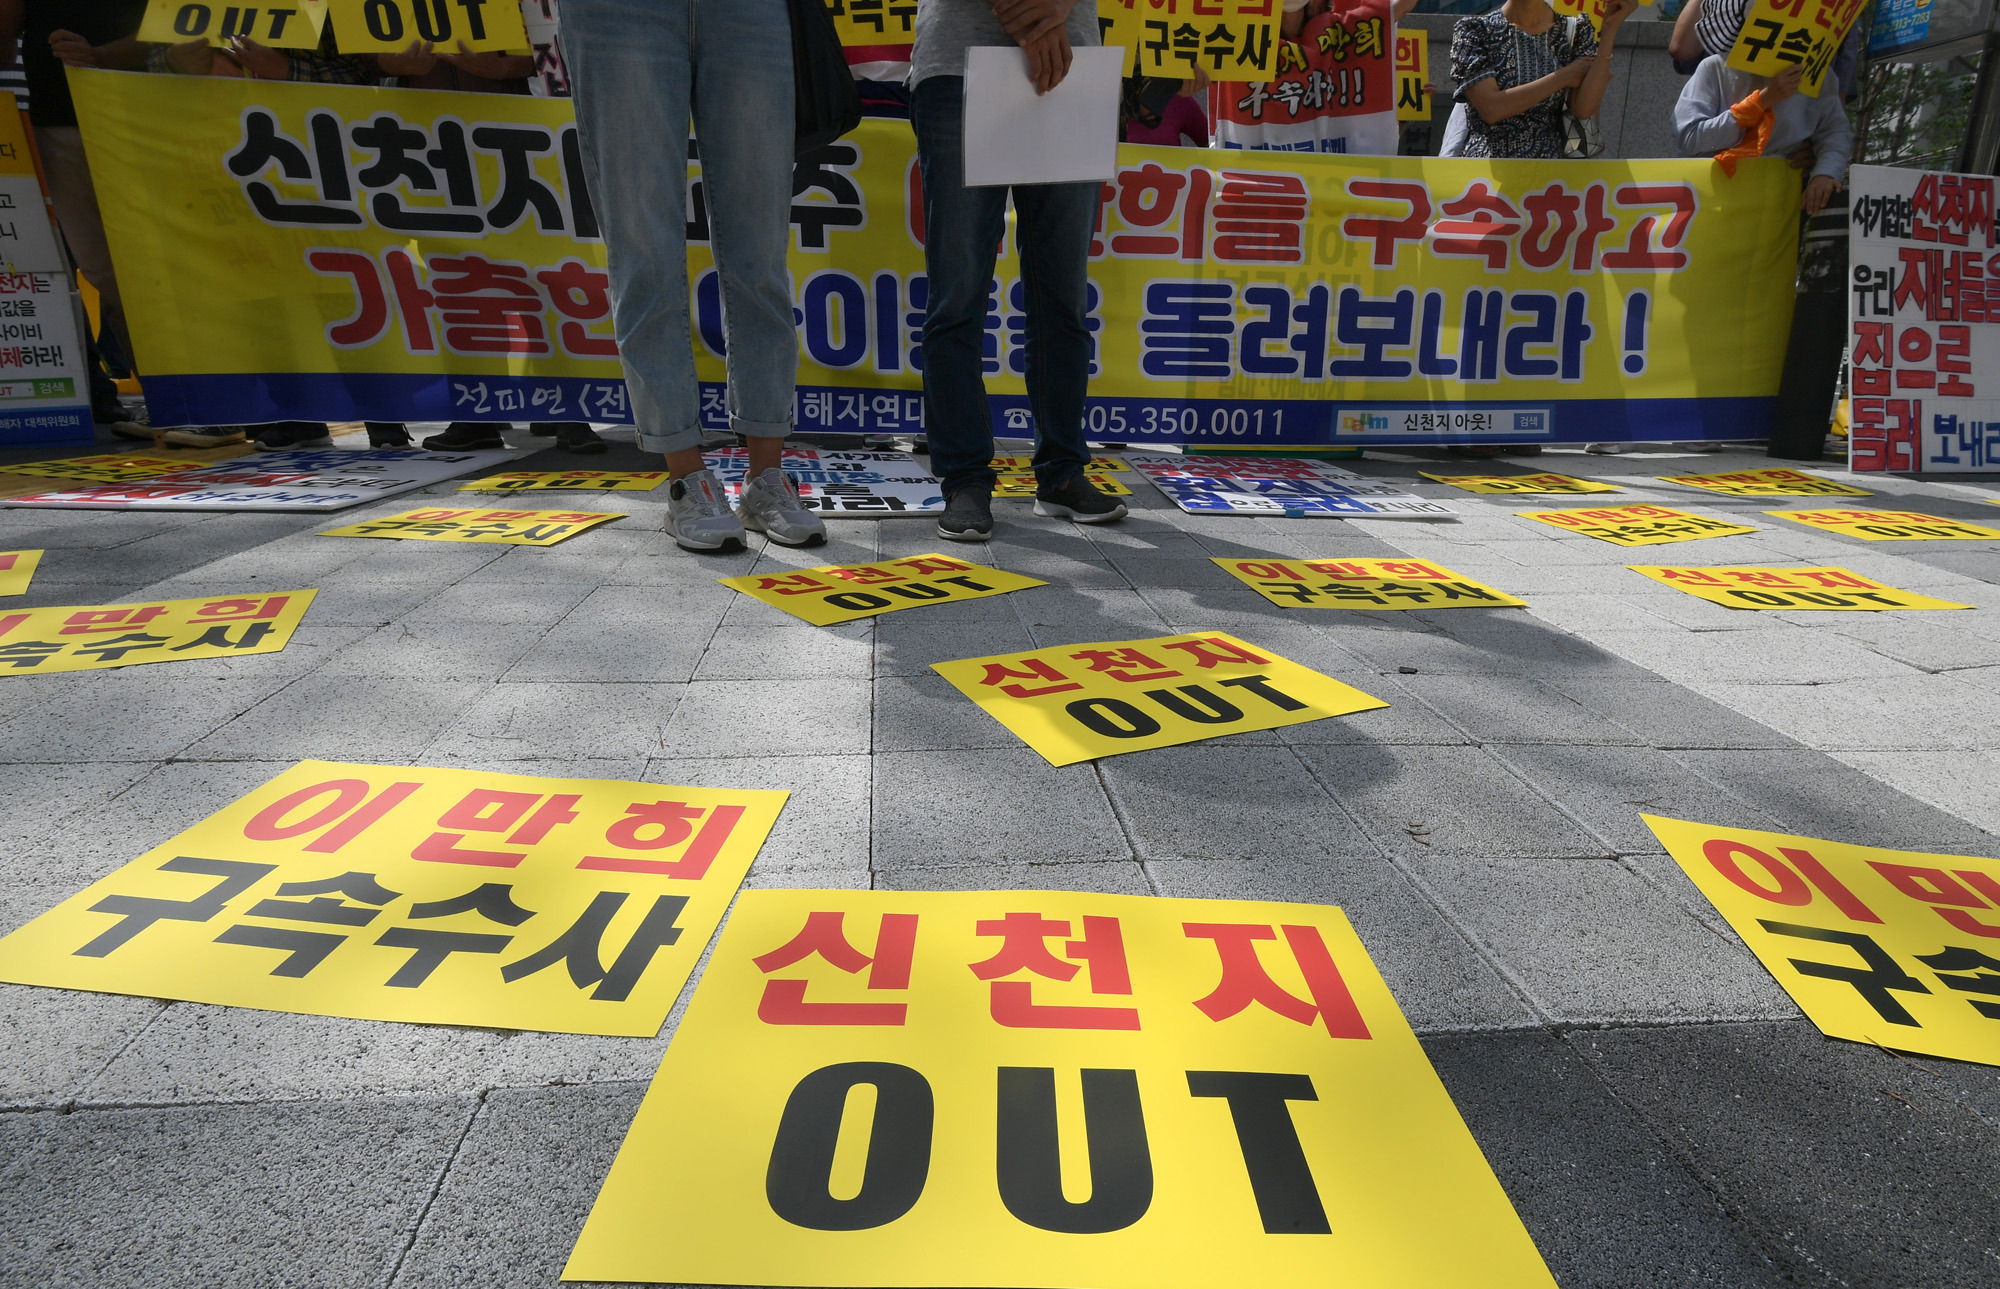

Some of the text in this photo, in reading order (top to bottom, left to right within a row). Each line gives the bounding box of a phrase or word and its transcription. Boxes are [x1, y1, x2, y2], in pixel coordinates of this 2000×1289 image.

[173, 3, 296, 39] OUT
[363, 0, 487, 42] OUT
[1145, 20, 1272, 70] 구속수사
[228, 112, 601, 238] 신천지
[1343, 182, 1697, 271] 구속하고
[1853, 264, 1895, 317] 우리
[1142, 283, 1592, 380] 돌려보내라
[1852, 321, 1974, 397] 집으로
[1343, 412, 1389, 432] Daum
[1404, 411, 1494, 434] 신천지 아웃!
[1519, 414, 1539, 428] 검색
[496, 479, 631, 489] OUT
[356, 521, 572, 541] 구속수사
[406, 511, 606, 523] 이만희
[1537, 505, 1682, 526] 이만희
[1587, 518, 1739, 542] 구속수사
[1792, 512, 1961, 525] 신천지
[1854, 525, 1992, 537] OUT
[758, 557, 972, 595] 신천지
[1235, 558, 1452, 582] 이만희
[1660, 569, 1883, 590] 신천지
[821, 575, 996, 611] OUT
[1252, 580, 1499, 606] 구속수사
[1724, 590, 1911, 607] OUT
[979, 637, 1273, 699] 신천지
[1064, 674, 1310, 740] OUT
[243, 777, 747, 882] 이만희
[70, 855, 685, 1003] 구속수사
[751, 911, 1374, 1040] 신천지
[765, 1060, 1334, 1236] OUT
